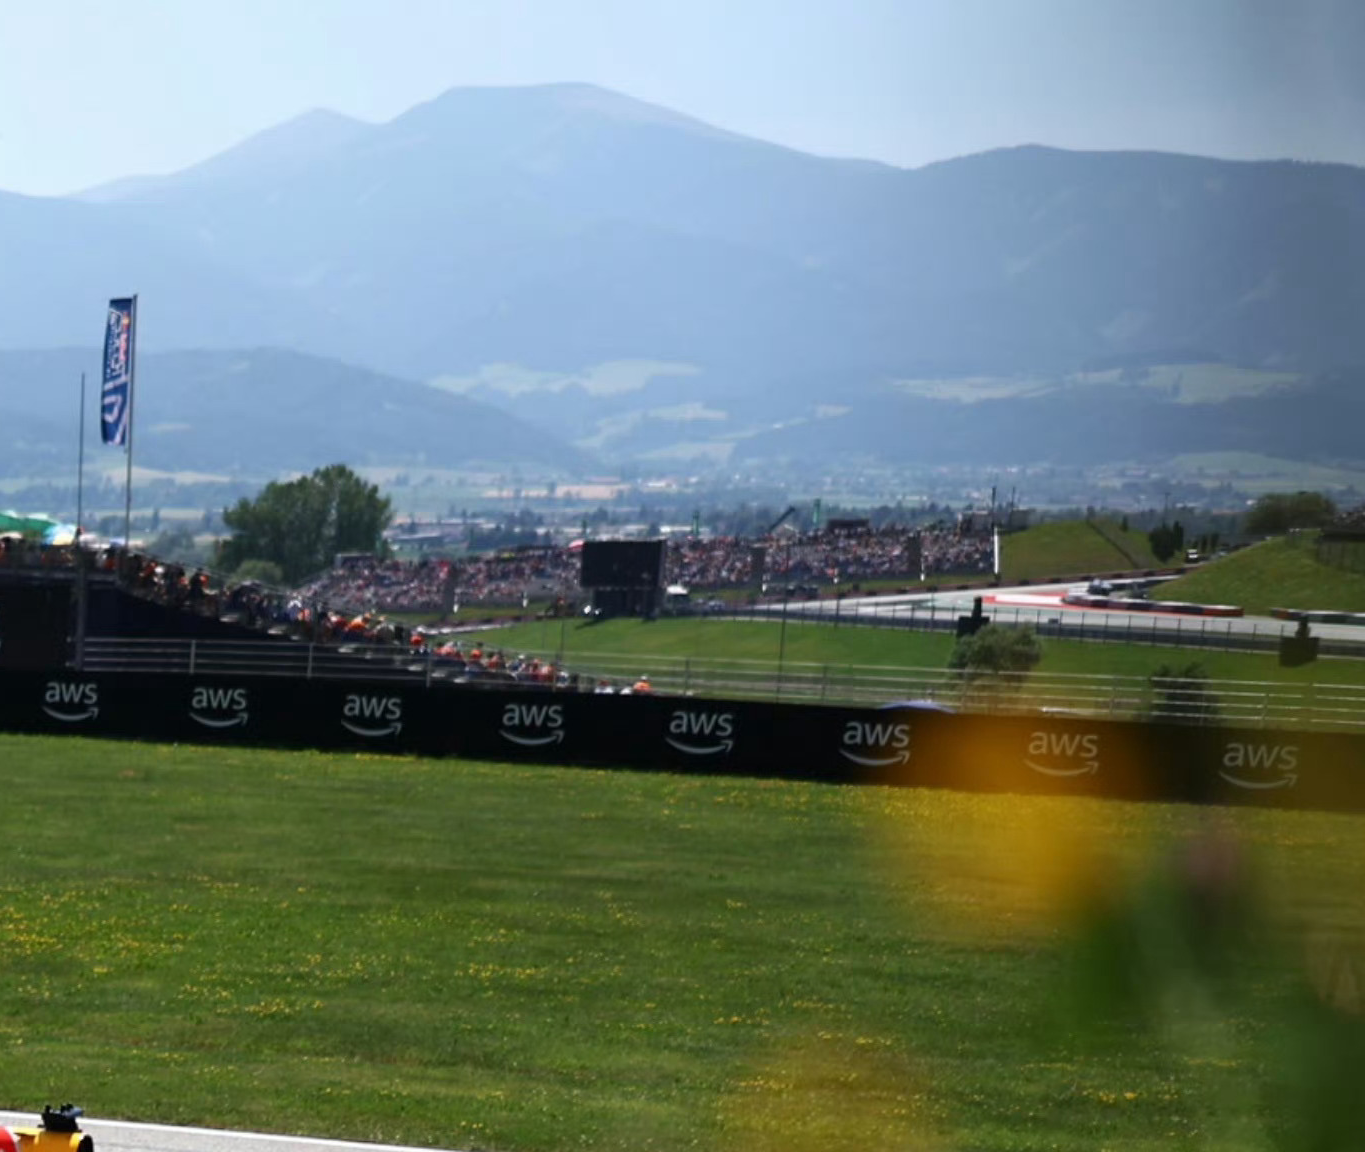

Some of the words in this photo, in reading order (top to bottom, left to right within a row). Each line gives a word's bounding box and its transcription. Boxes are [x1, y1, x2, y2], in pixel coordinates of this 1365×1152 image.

[45, 681, 97, 704] aws
[191, 687, 246, 709] aws
[343, 694, 401, 720] aws
[502, 704, 562, 728] aws
[670, 710, 733, 736] aws
[843, 720, 909, 748] aws
[1029, 731, 1097, 757] aws
[1223, 742, 1297, 770] aws
